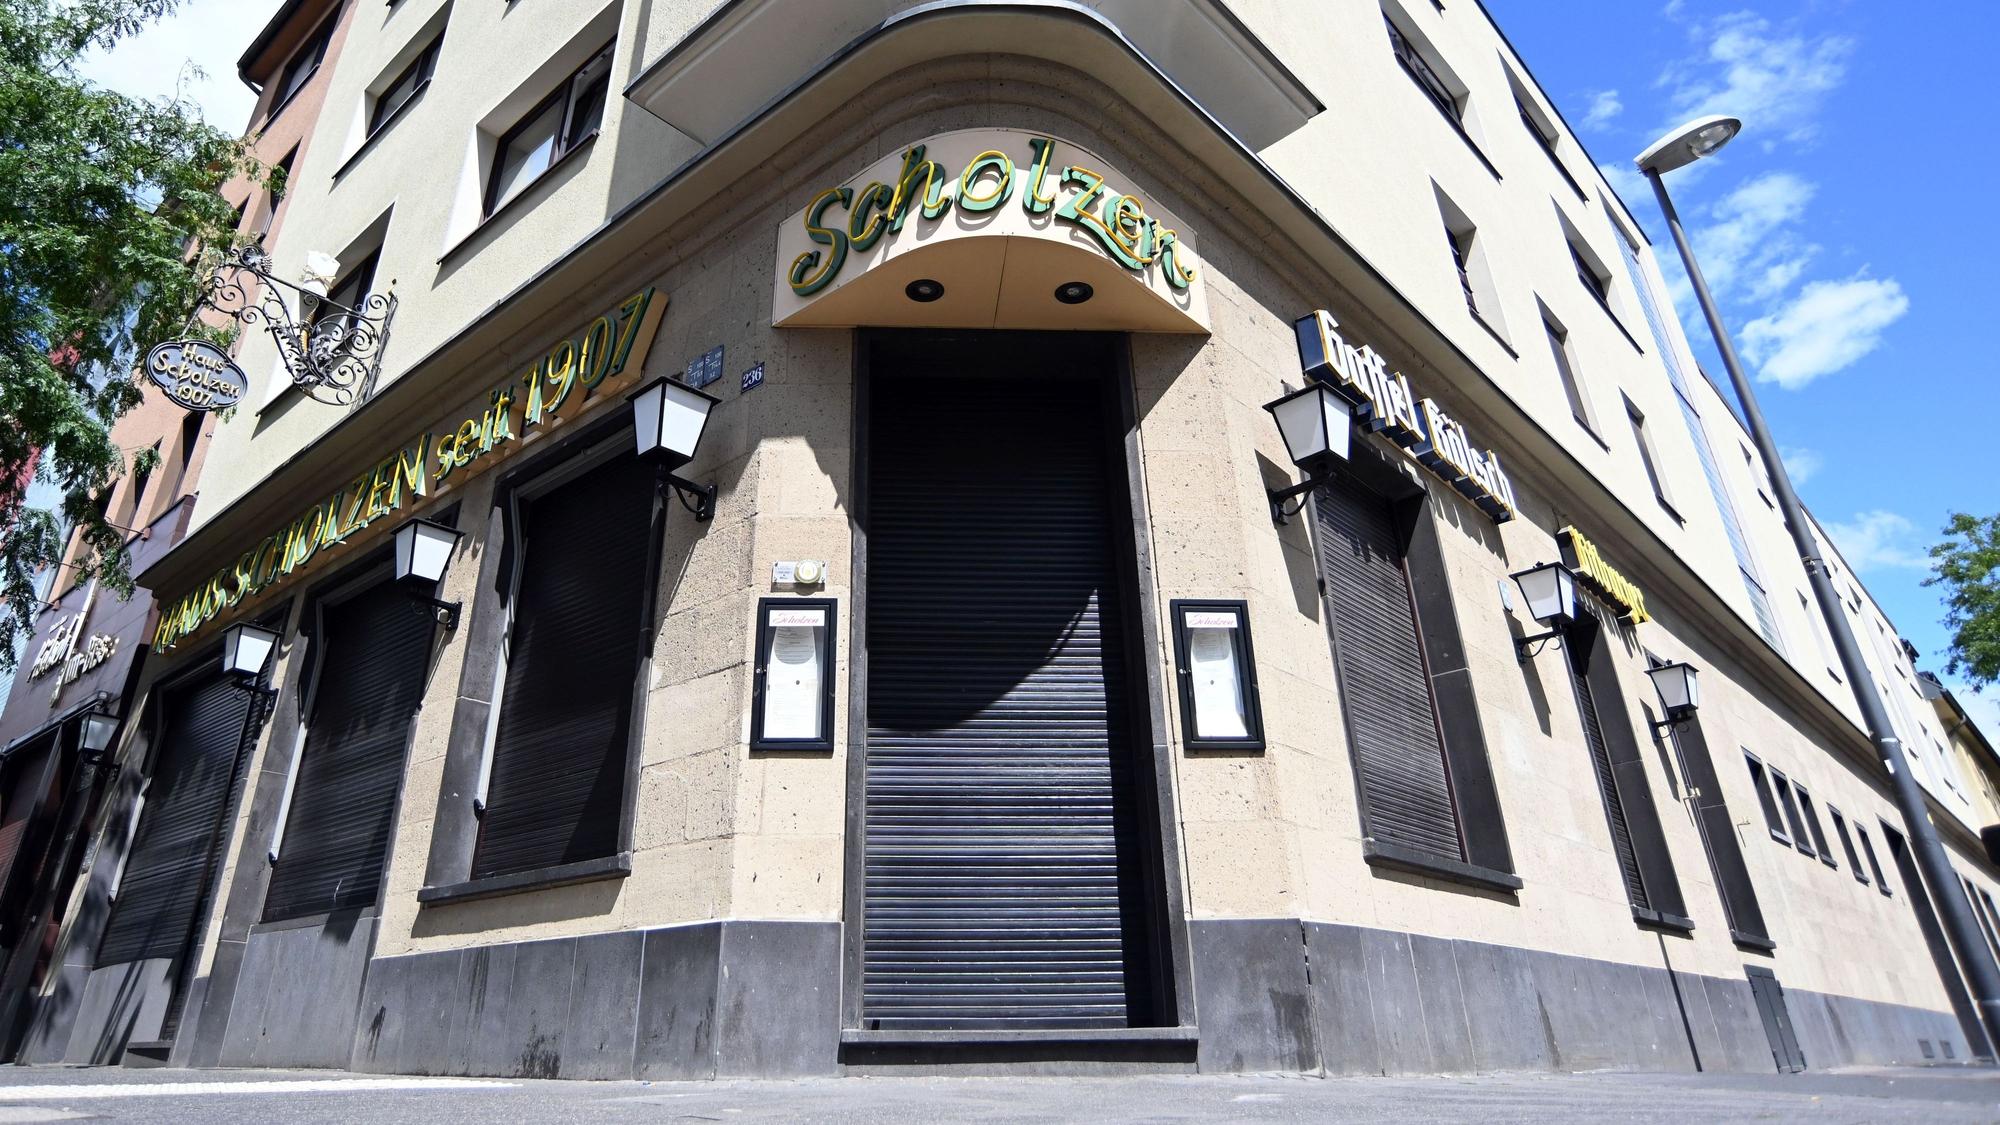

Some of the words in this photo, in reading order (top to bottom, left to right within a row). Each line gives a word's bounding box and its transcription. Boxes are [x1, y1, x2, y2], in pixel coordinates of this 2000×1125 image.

[788, 138, 1196, 297] Scholzen
[154, 351, 240, 396] Scholzen
[182, 343, 225, 371] Haus
[743, 367, 763, 388] 236
[1315, 309, 1426, 442] Gaffel
[177, 385, 214, 406] 1907
[152, 568, 227, 655] HAUS
[227, 432, 432, 607] SCHOLZEN
[432, 385, 515, 480] seit
[521, 287, 656, 427] 1907
